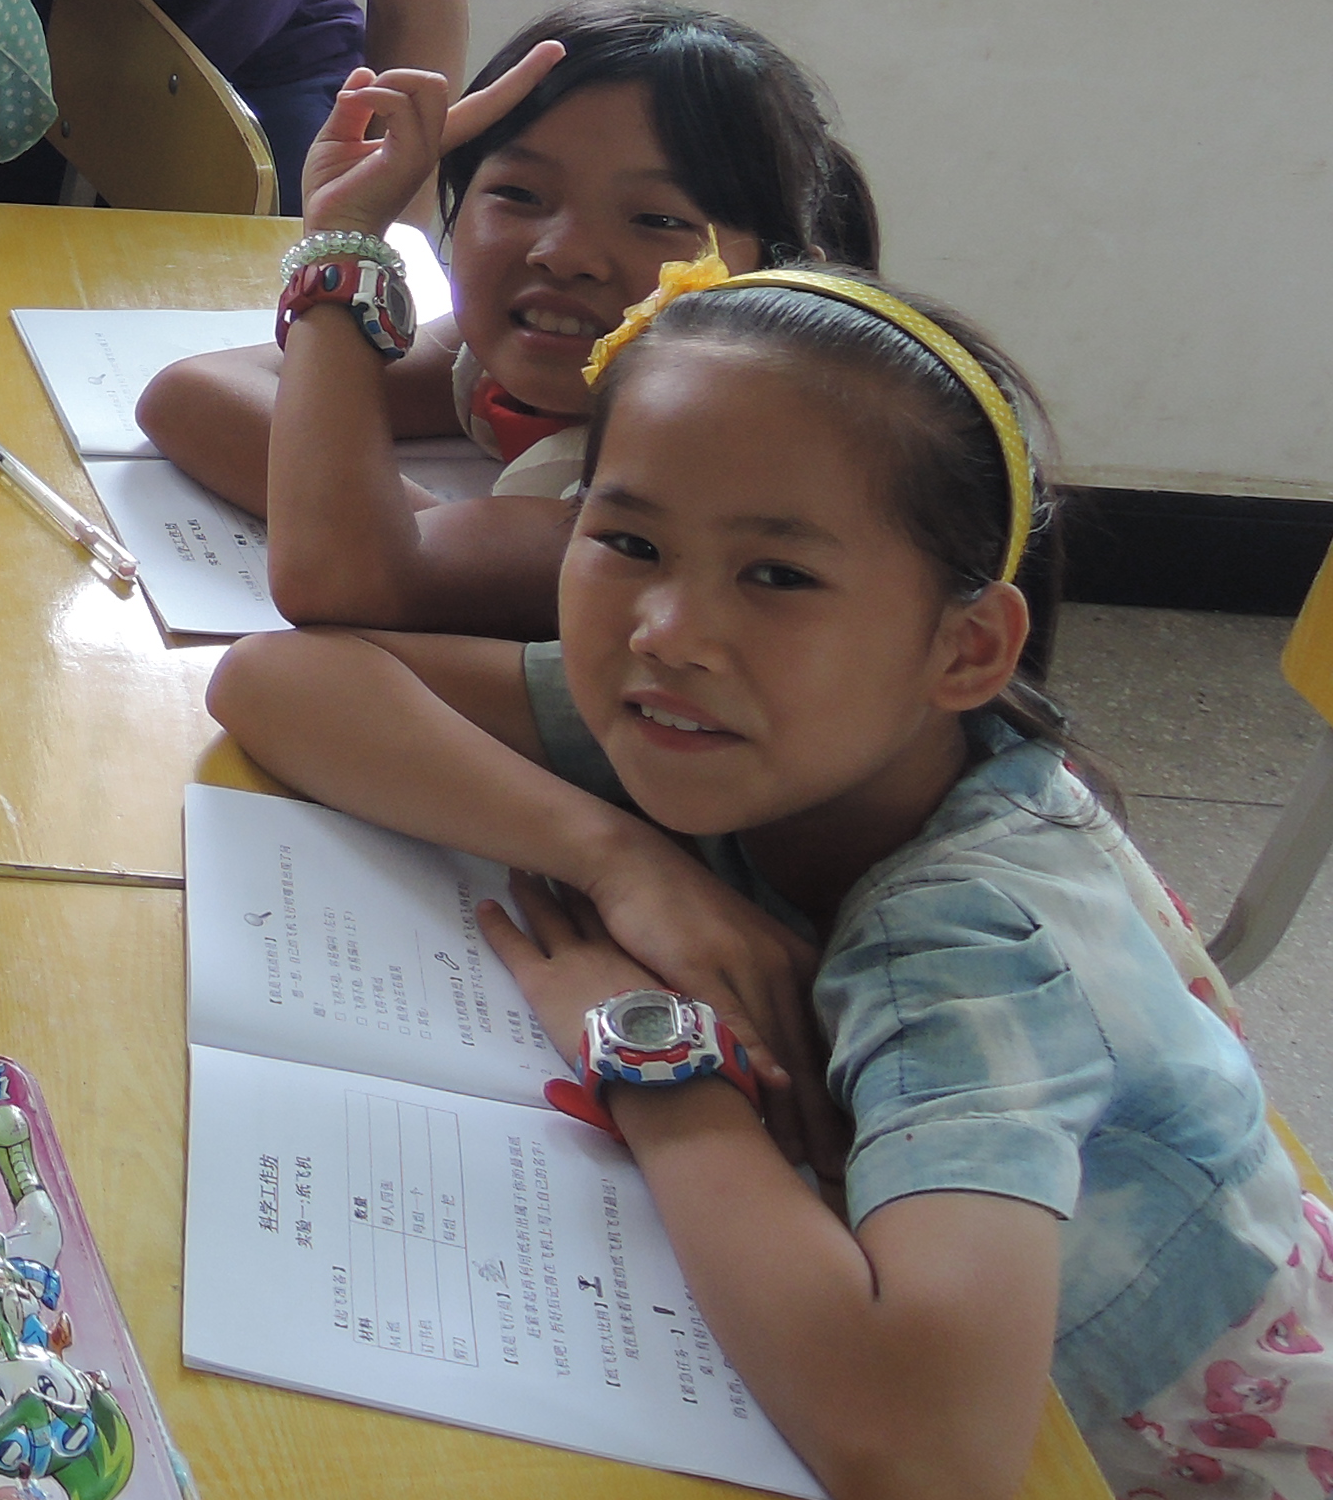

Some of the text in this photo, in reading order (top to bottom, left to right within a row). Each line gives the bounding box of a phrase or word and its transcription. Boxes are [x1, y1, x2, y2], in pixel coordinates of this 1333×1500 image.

[258, 1155, 279, 1234] 科学工作坊
